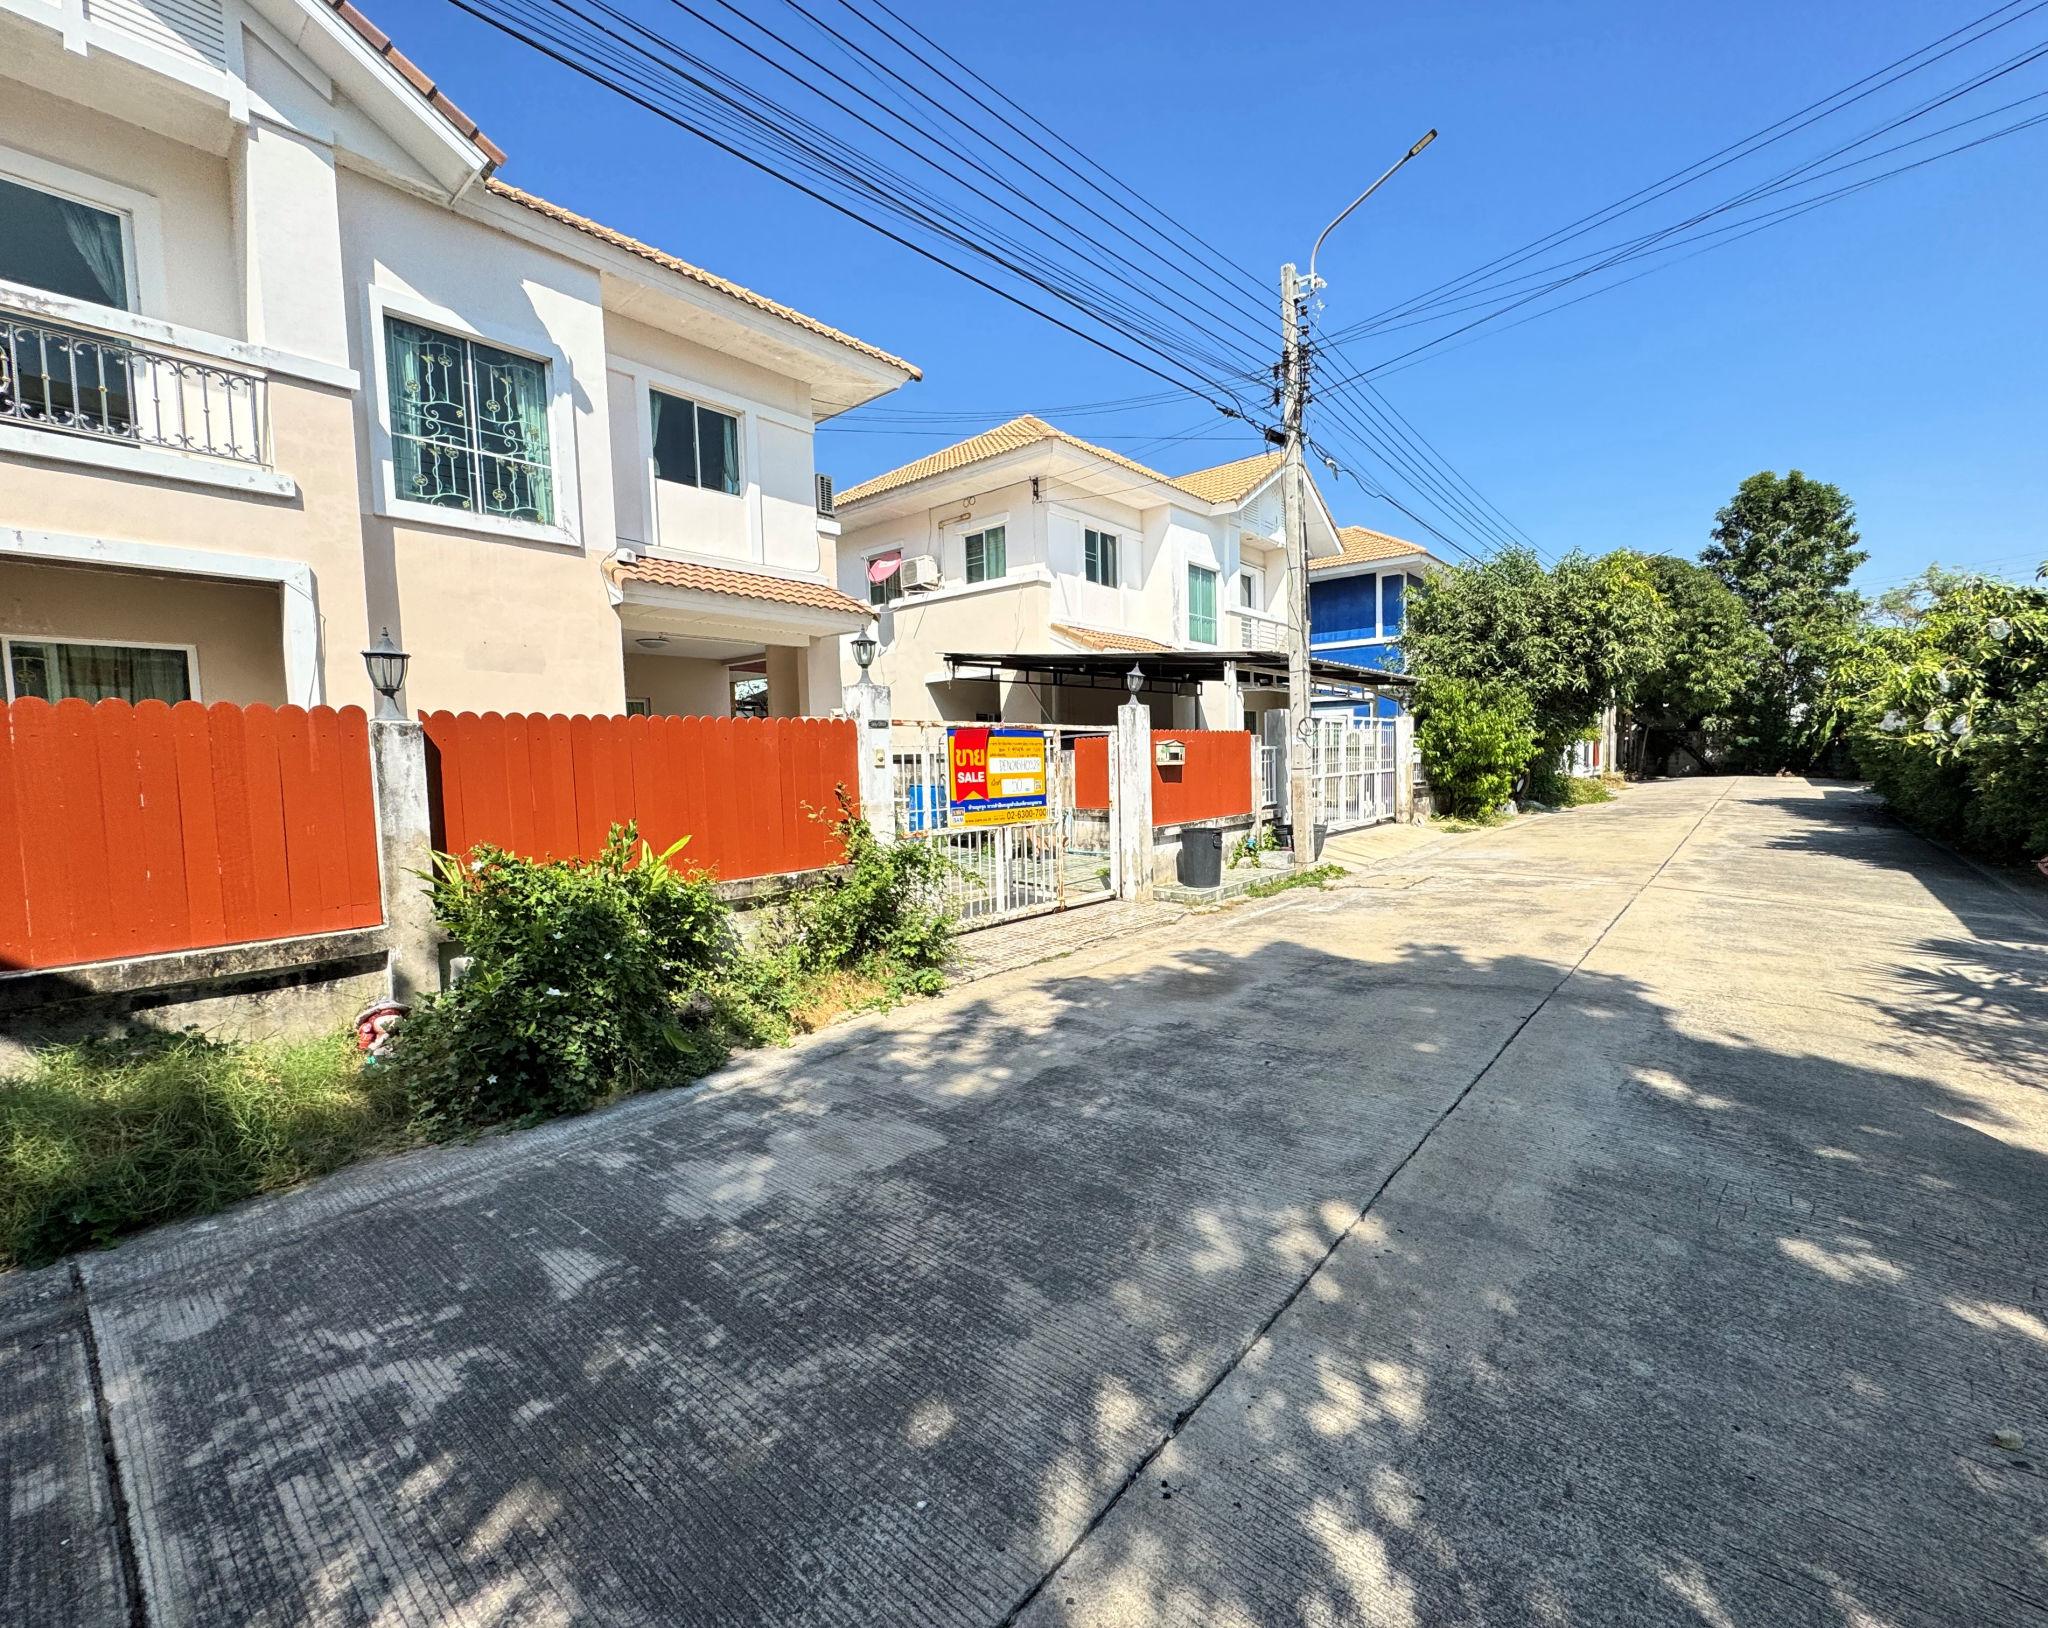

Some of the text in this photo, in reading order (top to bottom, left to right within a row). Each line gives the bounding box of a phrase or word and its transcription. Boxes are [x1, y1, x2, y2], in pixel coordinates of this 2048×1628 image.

[956, 749, 985, 767] ขาย
[957, 771, 985, 784] SALE
[1007, 808, 1046, 820] 02-6300-700
